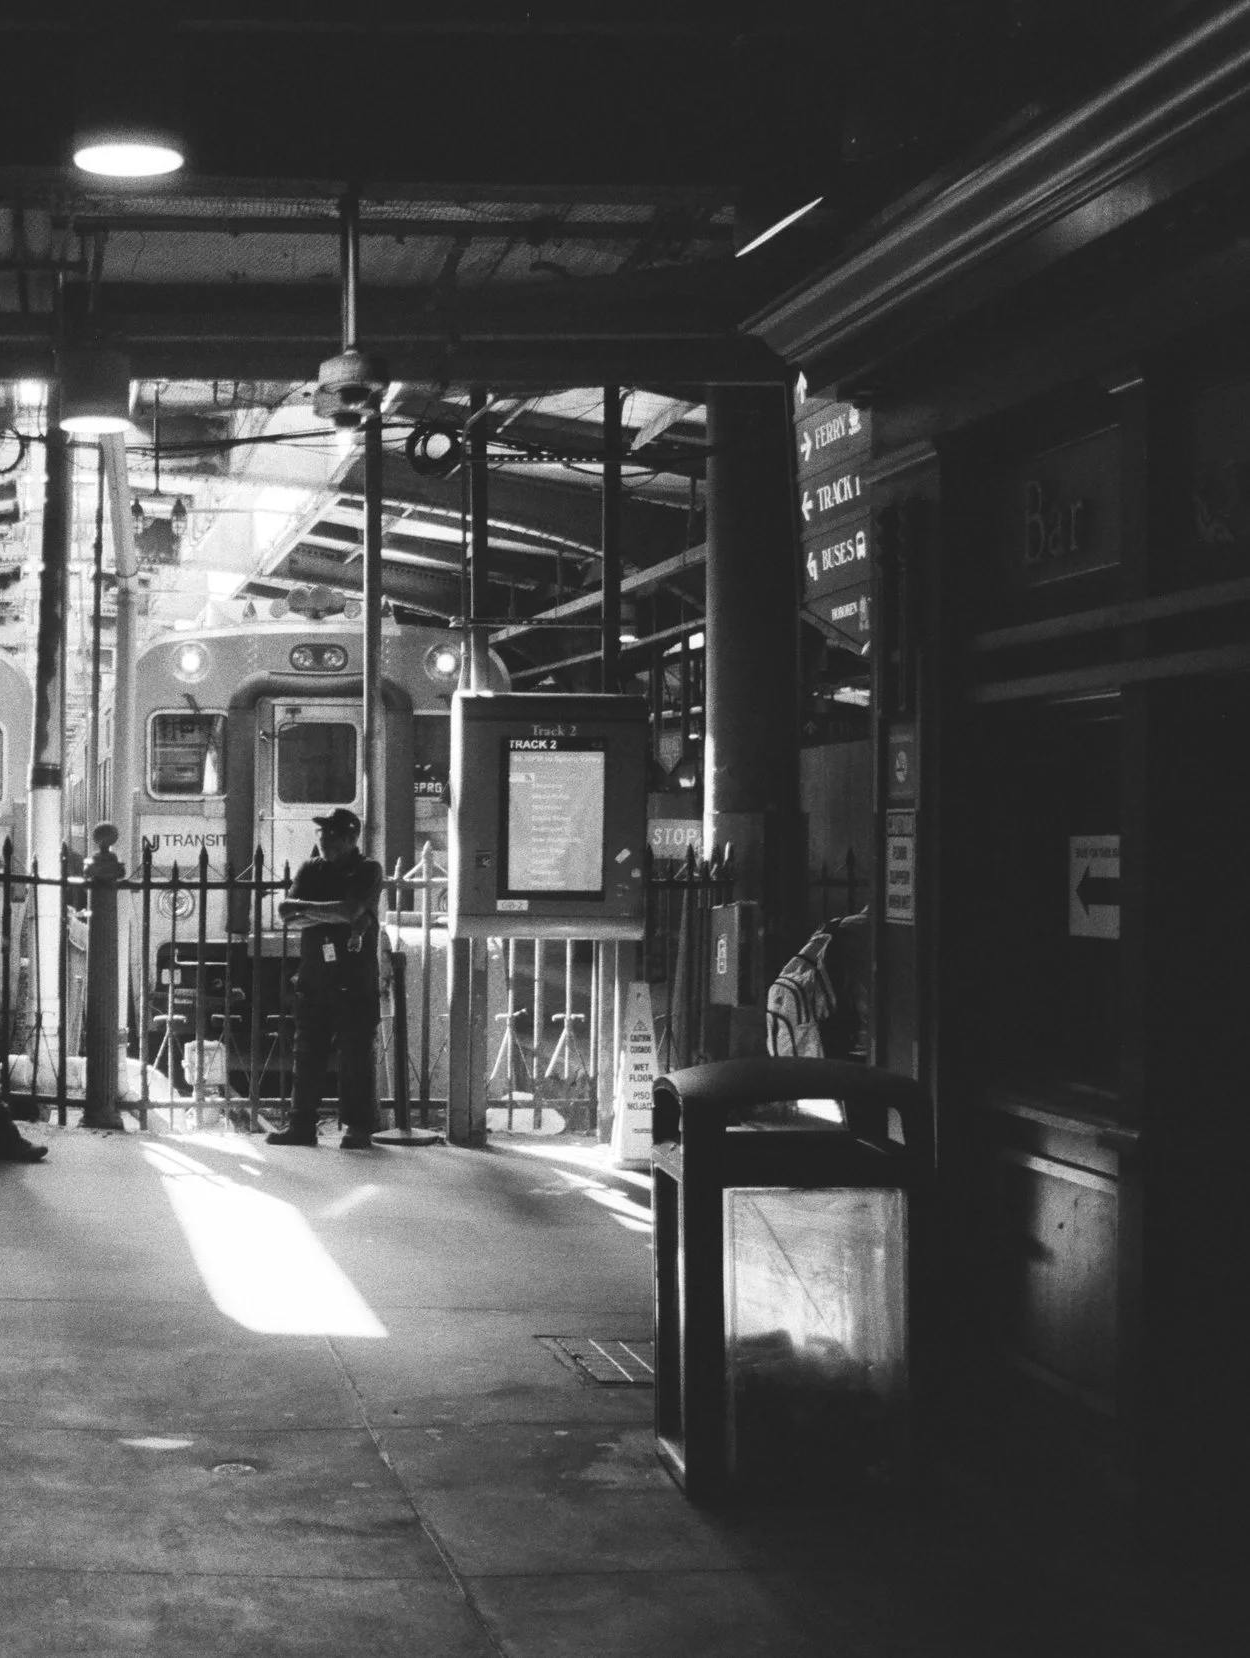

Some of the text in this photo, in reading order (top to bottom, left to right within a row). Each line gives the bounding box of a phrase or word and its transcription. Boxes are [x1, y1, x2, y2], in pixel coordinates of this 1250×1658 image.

[814, 413, 847, 450] FERRY
[817, 475, 853, 512] TRACK
[1020, 480, 1084, 565] Bar
[821, 539, 855, 571] BUSES
[530, 724, 579, 738] Track 2
[508, 739, 558, 751] TRACK 2
[141, 833, 228, 853] NJ TRANSIT
[652, 828, 697, 846] STOP
[633, 1063, 649, 1072] WET
[629, 1074, 654, 1083] FLOOR
[633, 1091, 651, 1100] PISO
